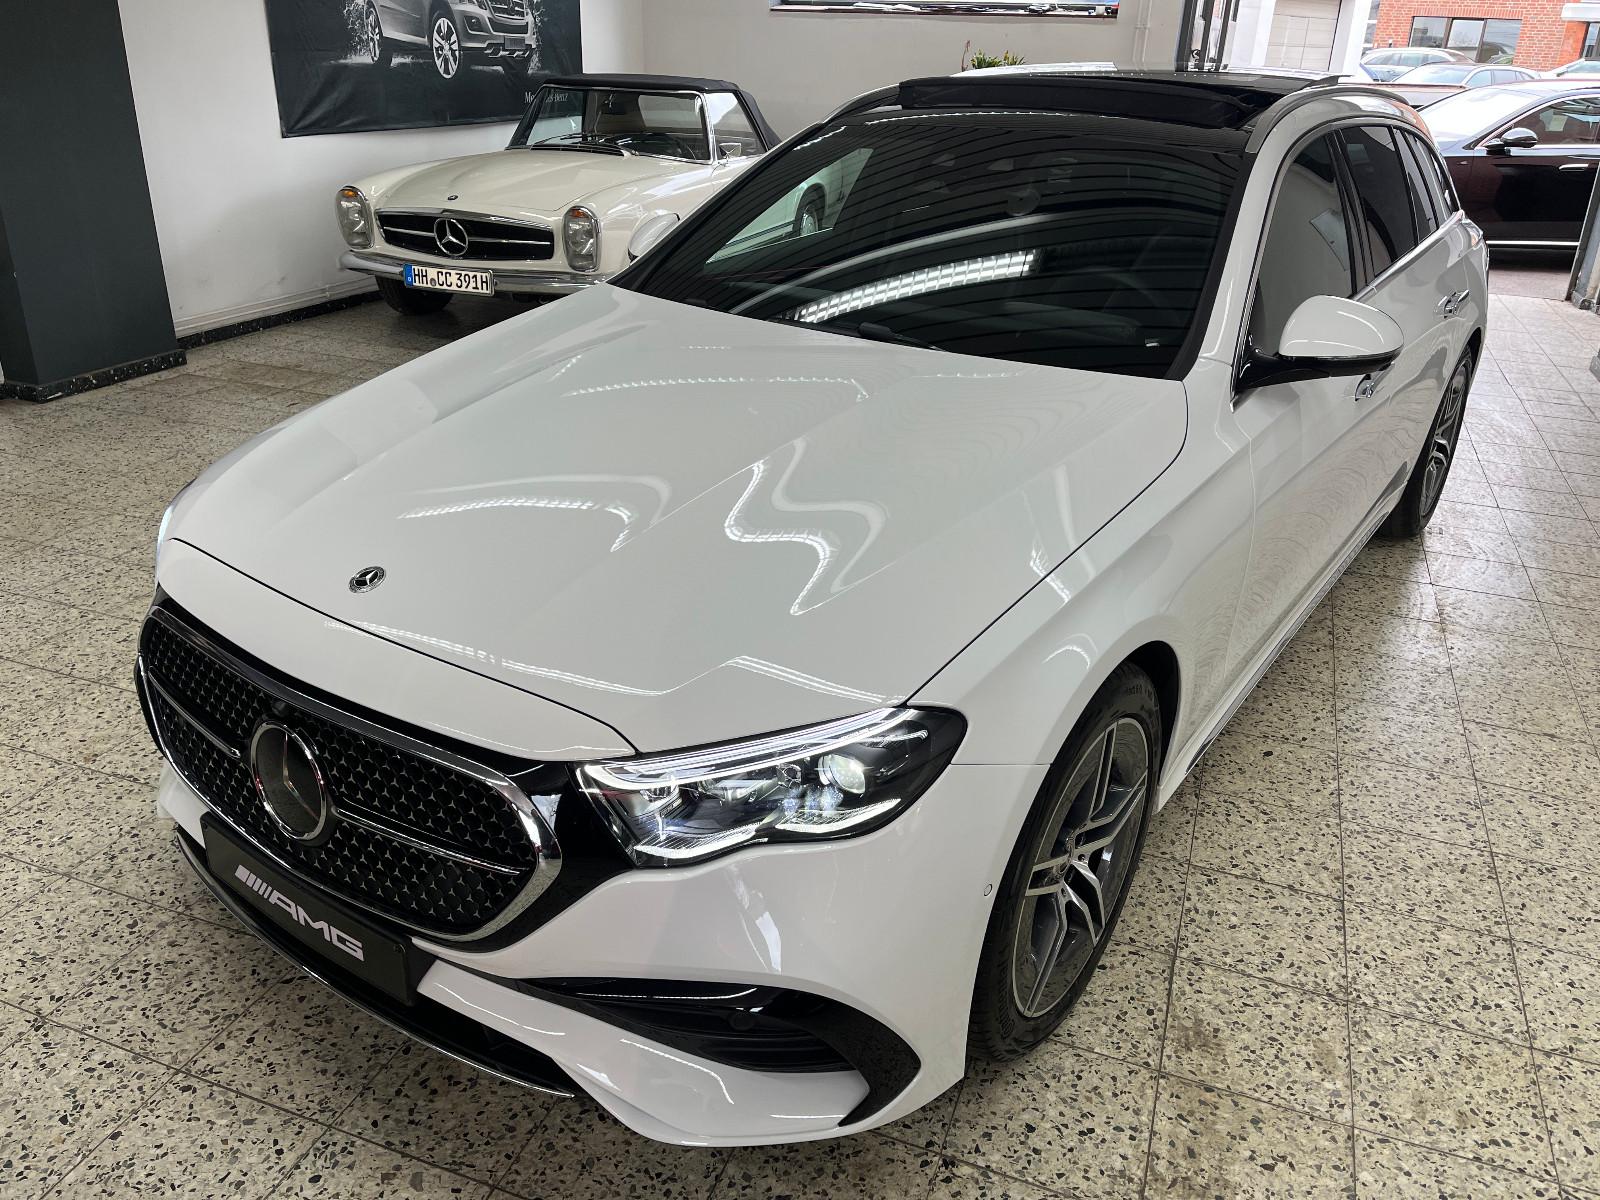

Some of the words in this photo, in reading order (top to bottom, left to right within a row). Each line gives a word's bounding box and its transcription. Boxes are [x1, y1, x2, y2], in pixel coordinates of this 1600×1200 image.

[413, 267, 429, 285] HH
[436, 271, 453, 287] CC
[455, 272, 489, 291] 391H
[268, 889, 364, 961] AMG
